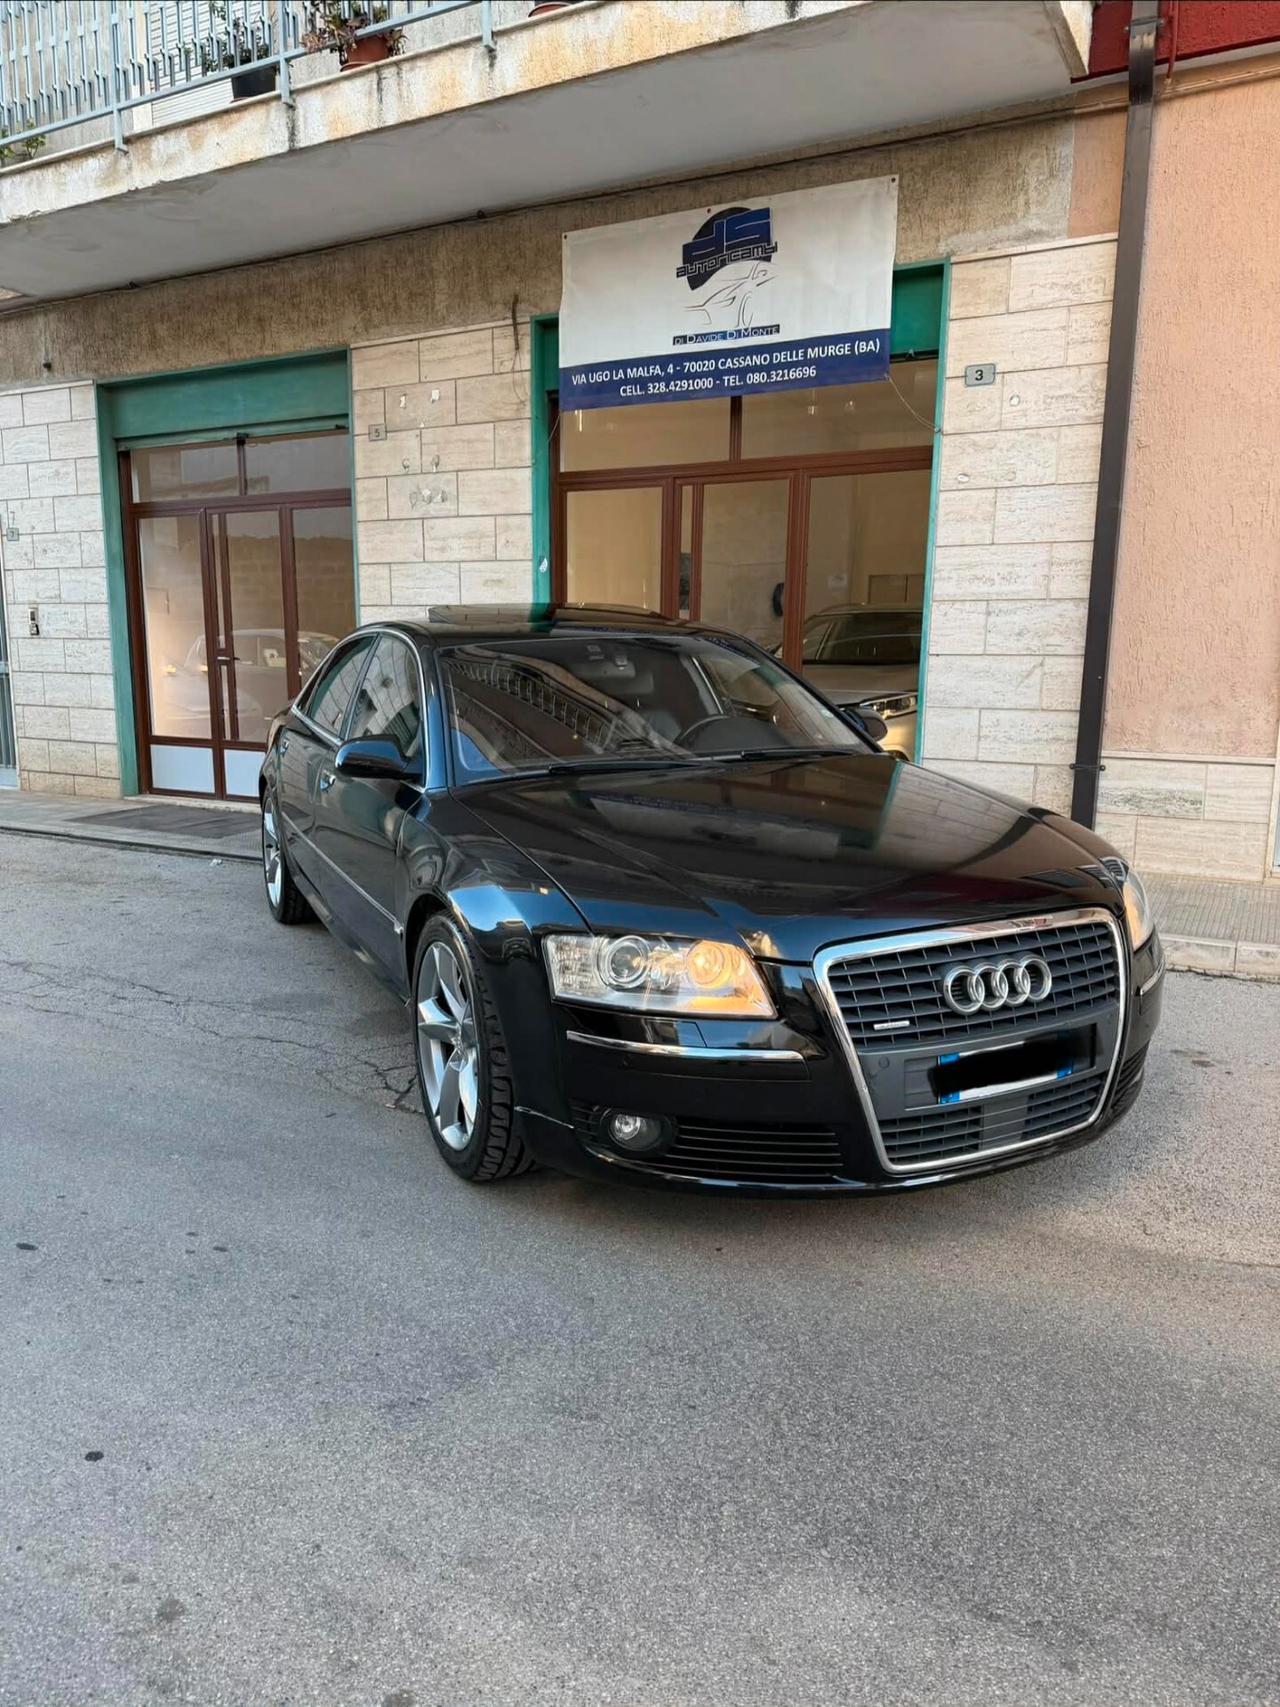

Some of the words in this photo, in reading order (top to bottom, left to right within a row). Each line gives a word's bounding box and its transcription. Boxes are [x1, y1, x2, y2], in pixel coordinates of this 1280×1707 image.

[571, 373, 587, 386] VIA
[588, 370, 610, 384] UGO
[612, 369, 625, 381] LA
[626, 365, 665, 379] MALFA,
[666, 364, 674, 375] 4
[683, 359, 716, 373] 70020
[718, 353, 770, 370] CASSANO
[772, 349, 805, 364] DELLE
[807, 342, 852, 360] MURGE
[854, 337, 880, 356] (BA)
[619, 385, 645, 397] CELL.
[647, 377, 714, 395] 328.4291000
[722, 375, 744, 387] TEL.
[746, 365, 817, 384] 080.3216696
[974, 369, 984, 381] 3
[374, 428, 380, 438] 5
